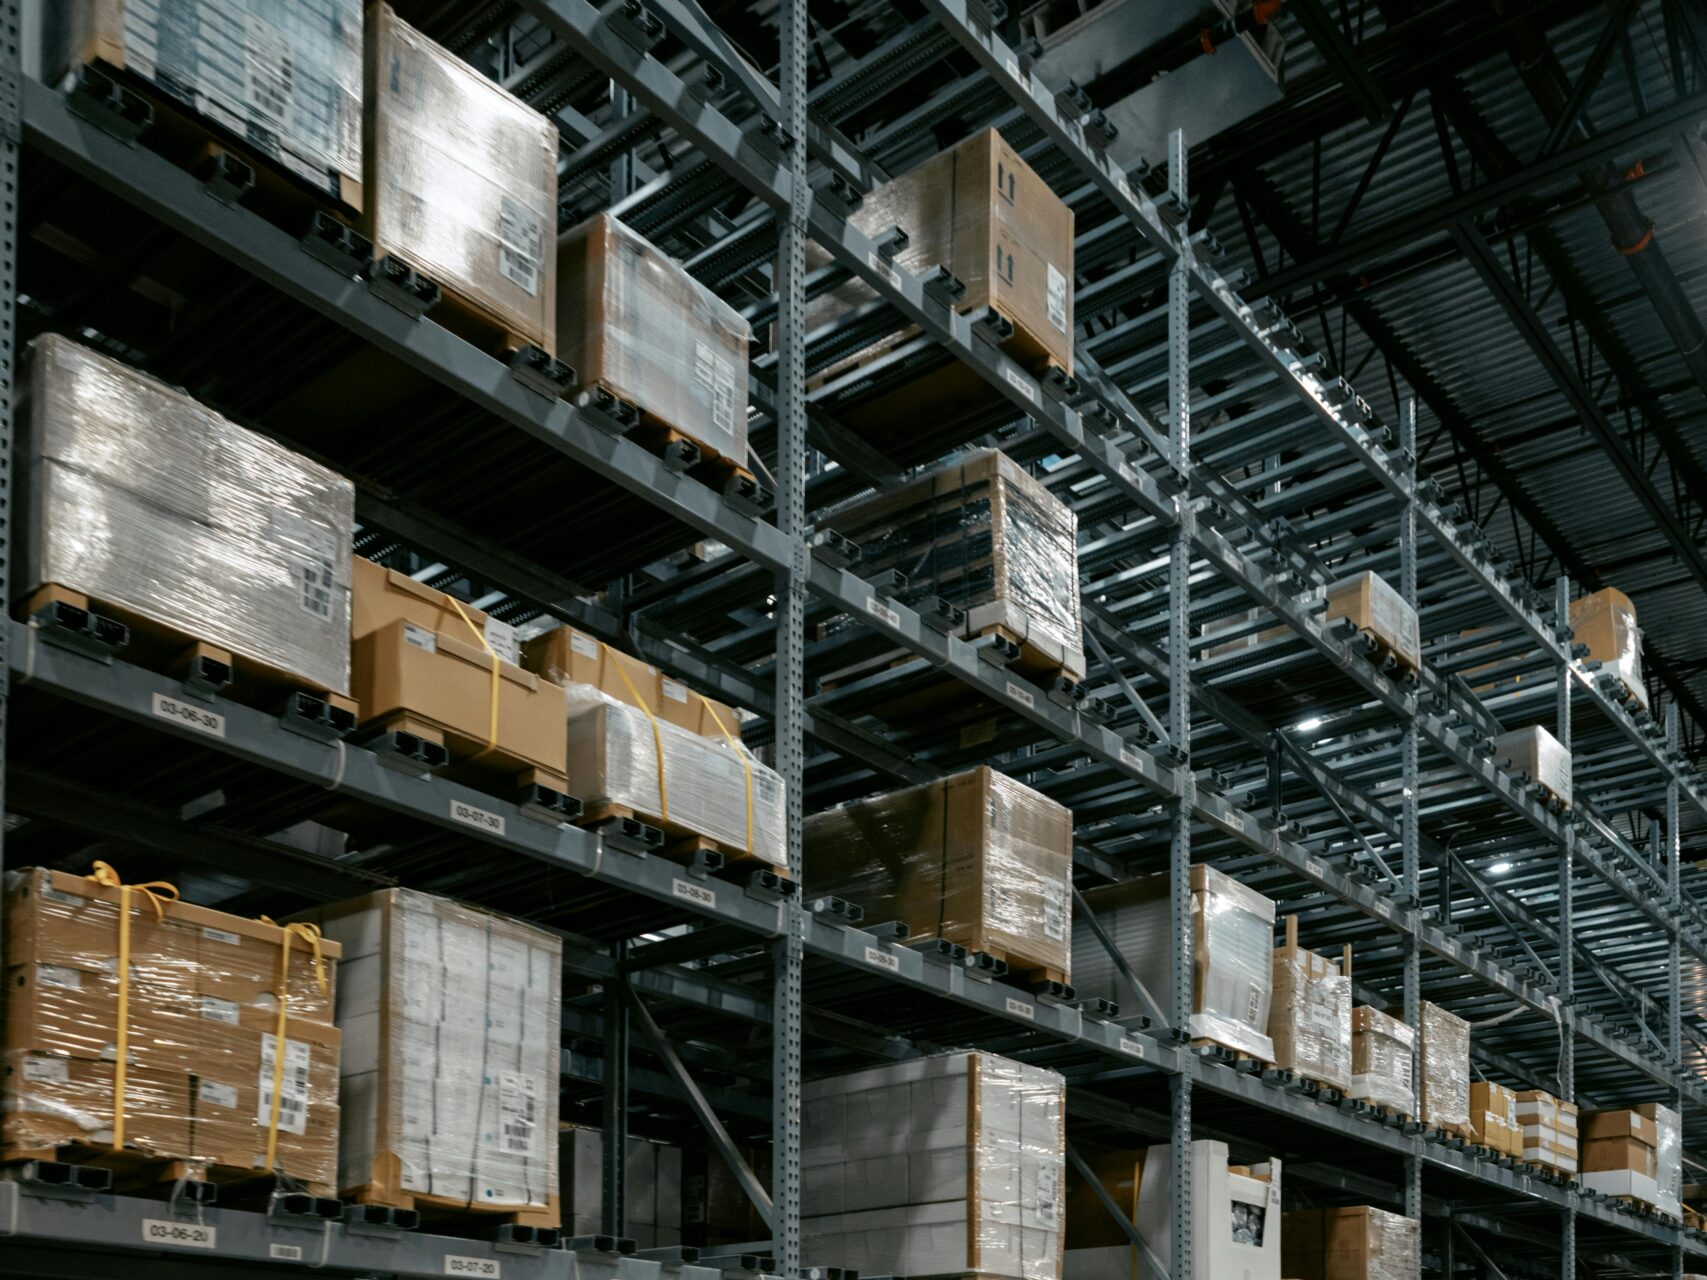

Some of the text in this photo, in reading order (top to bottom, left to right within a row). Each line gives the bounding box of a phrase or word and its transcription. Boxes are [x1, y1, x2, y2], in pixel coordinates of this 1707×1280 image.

[160, 699, 219, 730] 03-06-30
[456, 805, 500, 829] 03-07-30
[149, 1225, 209, 1242] 03-06-20
[450, 1259, 495, 1274] 03-07-20
